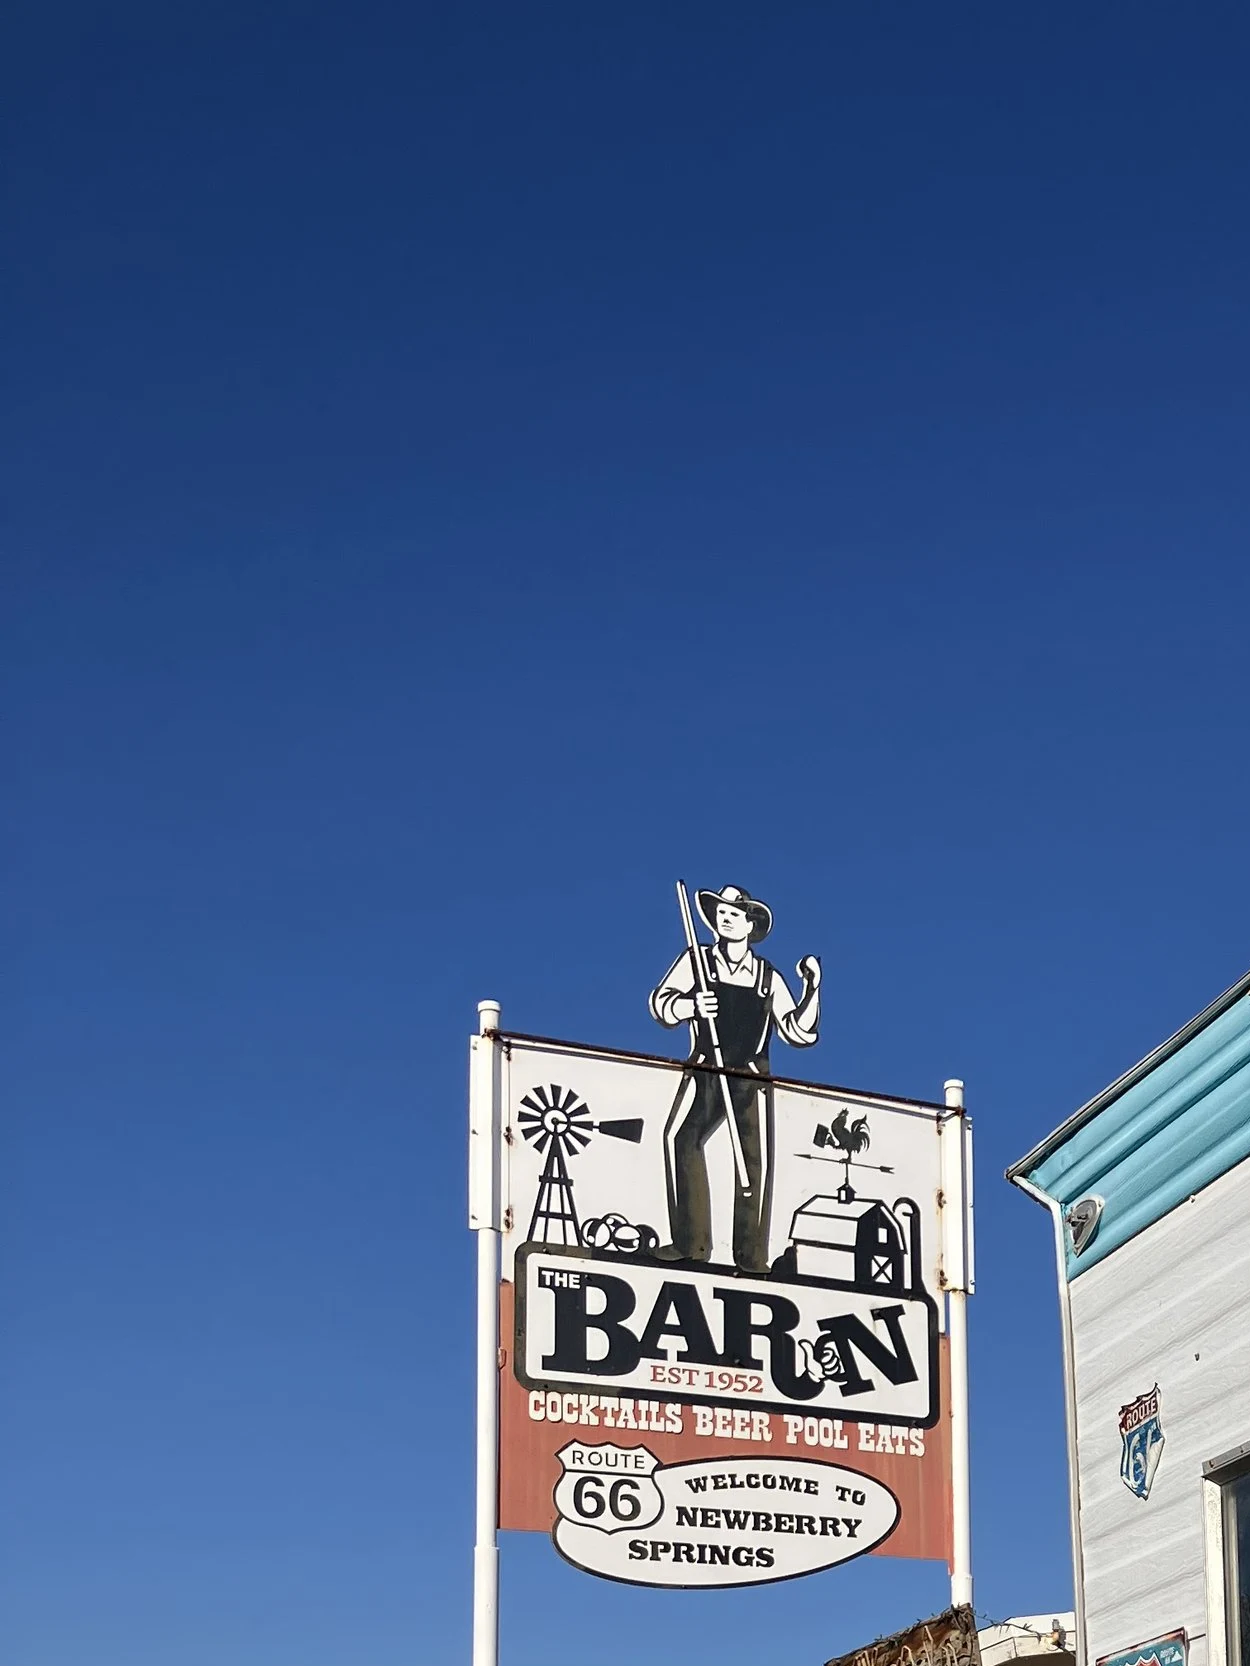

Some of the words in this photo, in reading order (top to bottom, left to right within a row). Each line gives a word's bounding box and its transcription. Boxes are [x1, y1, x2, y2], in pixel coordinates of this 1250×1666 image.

[542, 1270, 581, 1290] THE
[538, 1268, 920, 1401] BARN
[650, 1364, 700, 1385] EST
[704, 1371, 764, 1394] 1952
[528, 1390, 683, 1435] COCKTAILS
[693, 1408, 773, 1442] BEER
[783, 1415, 848, 1450] POOL
[858, 1422, 925, 1457] EATS
[1126, 1397, 1157, 1429] ROUTE
[572, 1450, 646, 1470] ROUTE
[573, 1476, 641, 1521] 66
[685, 1474, 819, 1496] WELCOME
[836, 1486, 866, 1506] TO
[676, 1505, 862, 1538] NEWBERRY
[628, 1539, 775, 1568] SPRINGS
